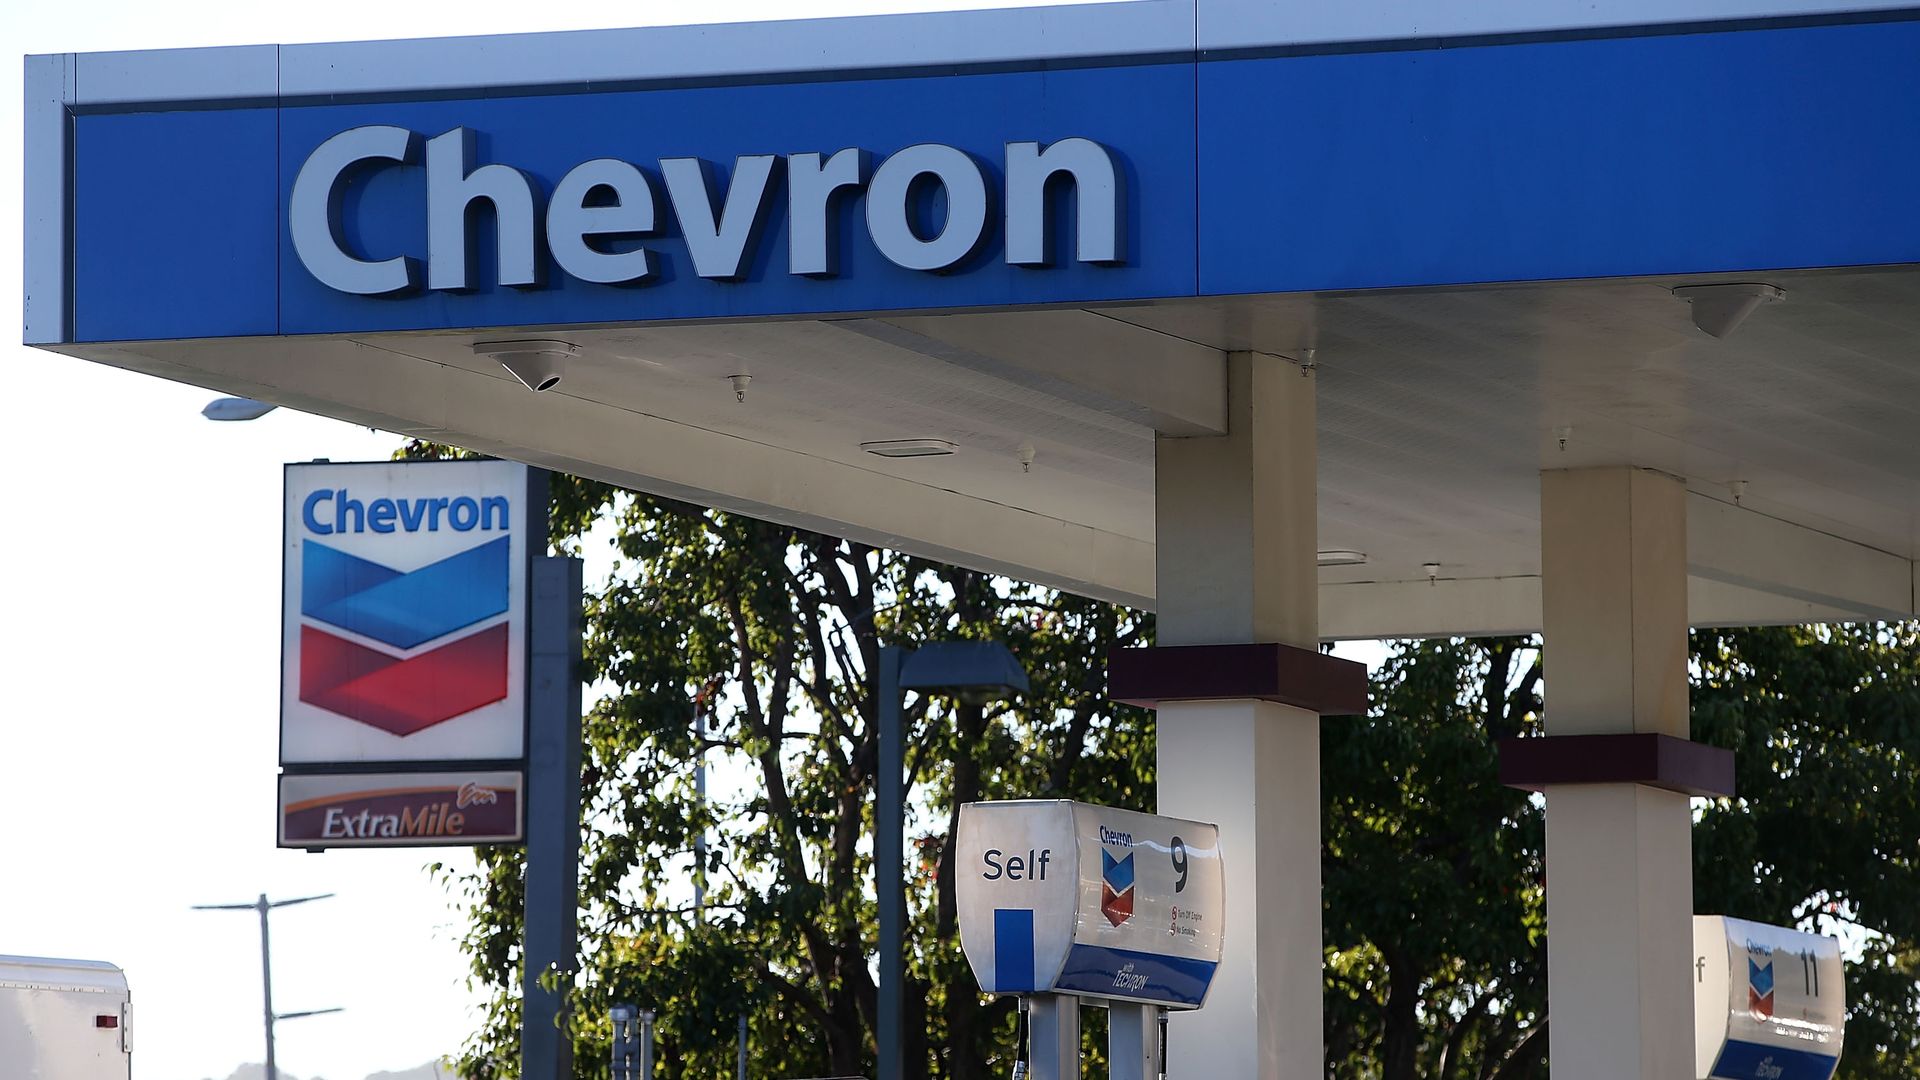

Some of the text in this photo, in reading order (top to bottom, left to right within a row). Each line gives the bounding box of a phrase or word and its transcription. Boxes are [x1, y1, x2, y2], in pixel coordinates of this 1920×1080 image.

[288, 124, 1123, 297] Chevron
[302, 488, 509, 535] Chevron
[321, 802, 465, 838] ExtraMile
[1099, 825, 1133, 848] Chevron
[983, 849, 1051, 881] Self
[1170, 836, 1188, 893] 9
[1800, 946, 1819, 997] 11
